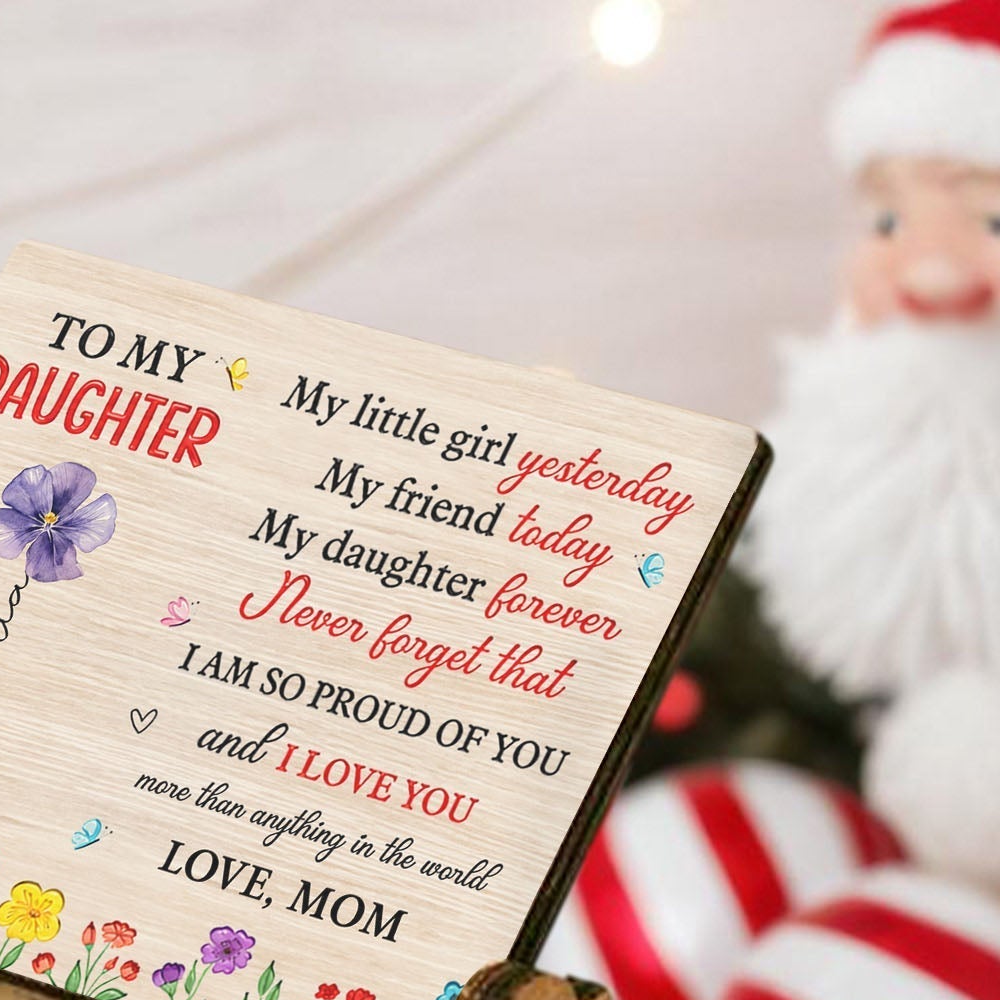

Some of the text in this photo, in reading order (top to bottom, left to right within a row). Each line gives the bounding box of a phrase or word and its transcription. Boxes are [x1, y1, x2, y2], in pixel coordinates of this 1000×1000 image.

[49, 312, 205, 383] TO MY
[280, 375, 695, 535] My little girl yesterday
[249, 508, 622, 641] My daughter forever
[314, 457, 613, 587] My friend today
[239, 570, 578, 698] Never forget that
[178, 643, 570, 777] I AM SO PROUD OF YOU
[196, 722, 479, 824] and I LOVE YOU
[133, 771, 503, 892] more than anything in the world
[158, 839, 408, 943] LOVE, MOM
